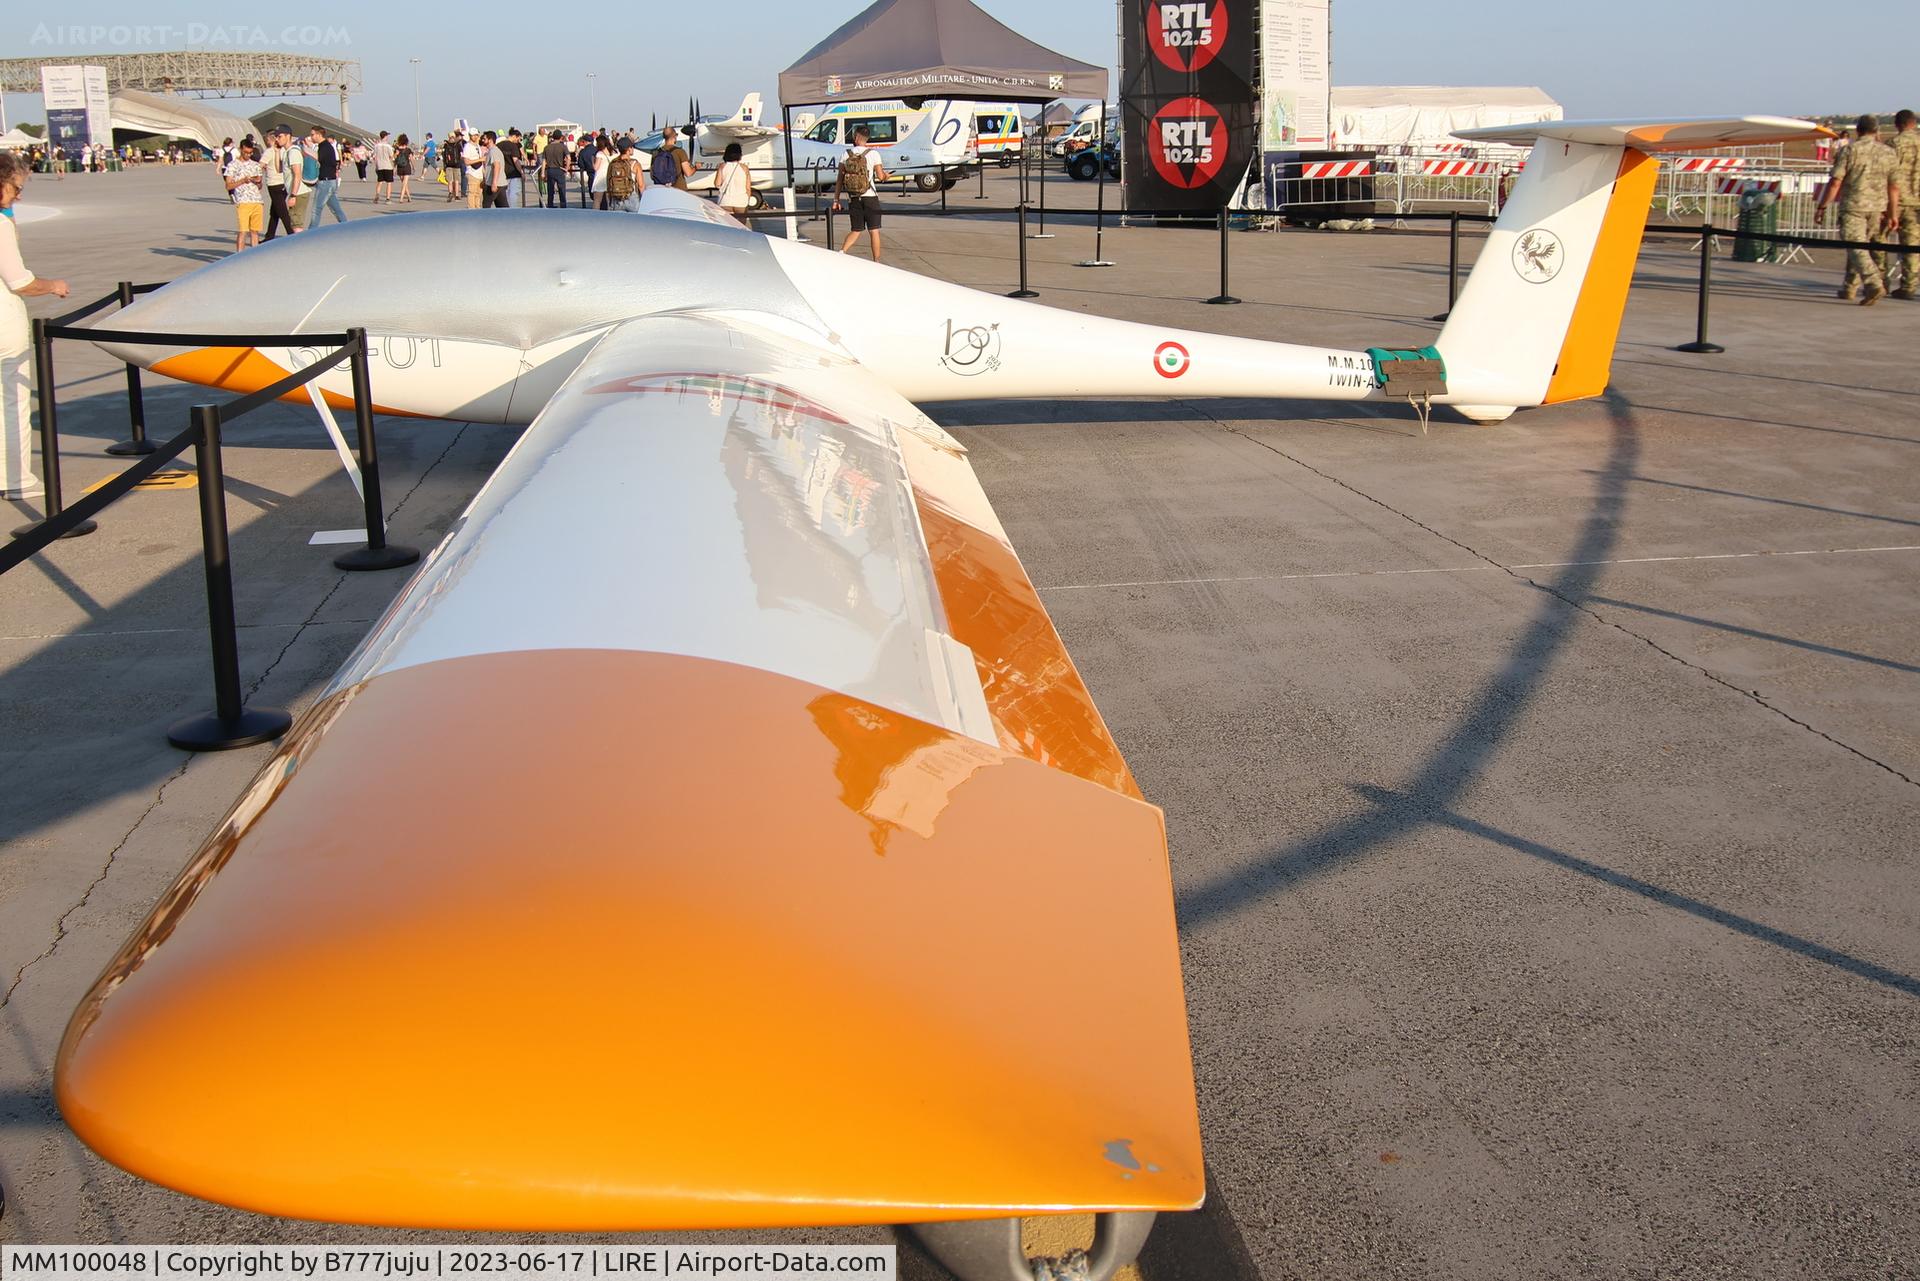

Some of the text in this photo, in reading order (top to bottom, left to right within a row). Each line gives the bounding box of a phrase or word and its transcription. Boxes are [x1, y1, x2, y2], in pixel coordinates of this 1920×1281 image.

[1161, 3, 1212, 30] RTL
[1162, 29, 1213, 47] 102.5
[854, 76, 920, 90] AERONAUTICA
[921, 74, 965, 84] MILITARE
[848, 103, 895, 112] MISERICORDIA
[1161, 121, 1212, 146] RTL
[1163, 147, 1213, 164] 102.5
